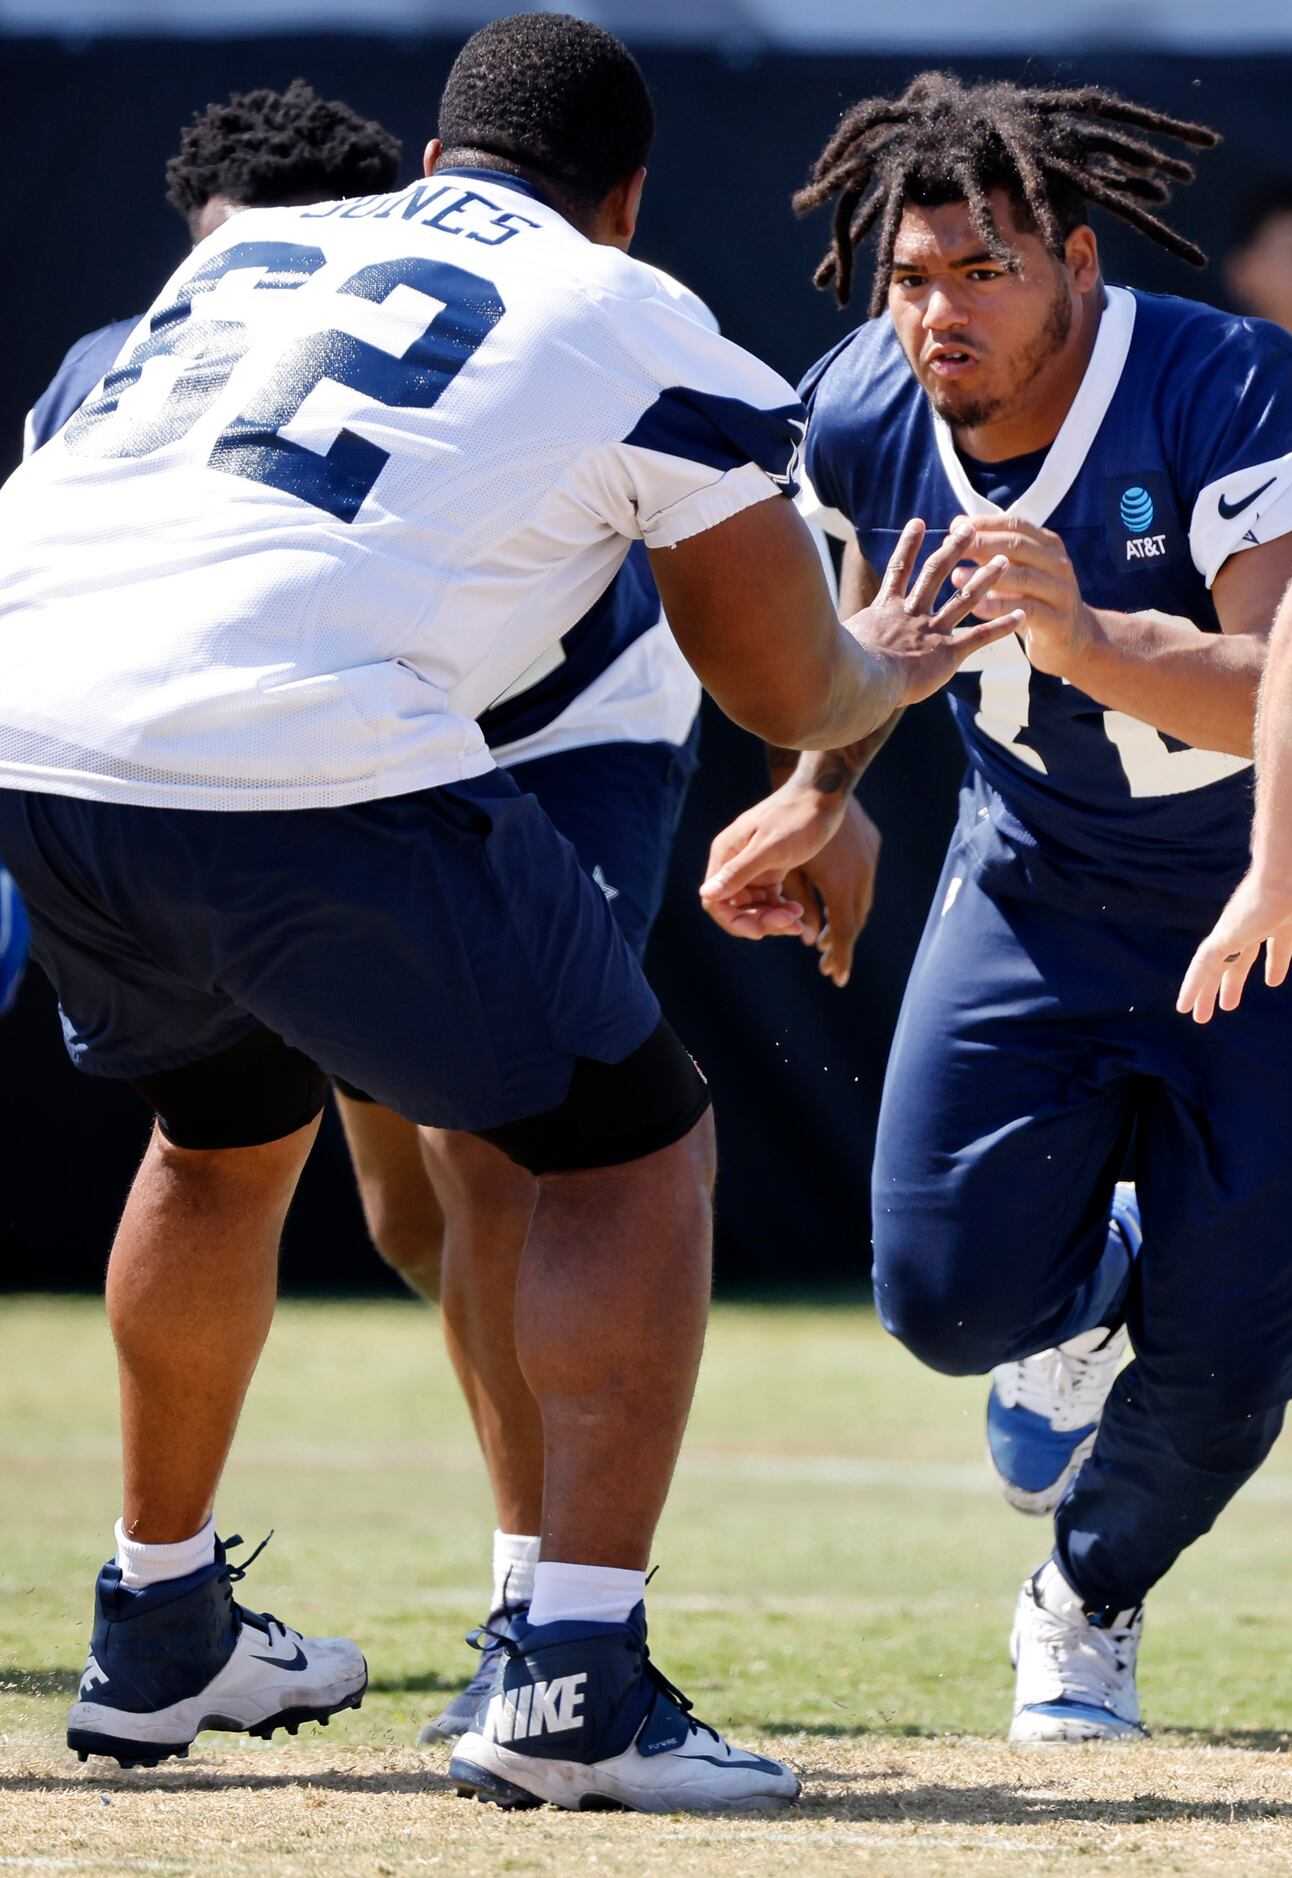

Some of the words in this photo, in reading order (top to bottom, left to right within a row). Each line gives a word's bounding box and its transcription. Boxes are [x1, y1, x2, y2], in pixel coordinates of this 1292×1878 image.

[299, 184, 543, 246] JONES
[63, 240, 506, 525] 62
[1126, 534, 1166, 561] AT&T
[482, 1671, 588, 1744] NIKE
